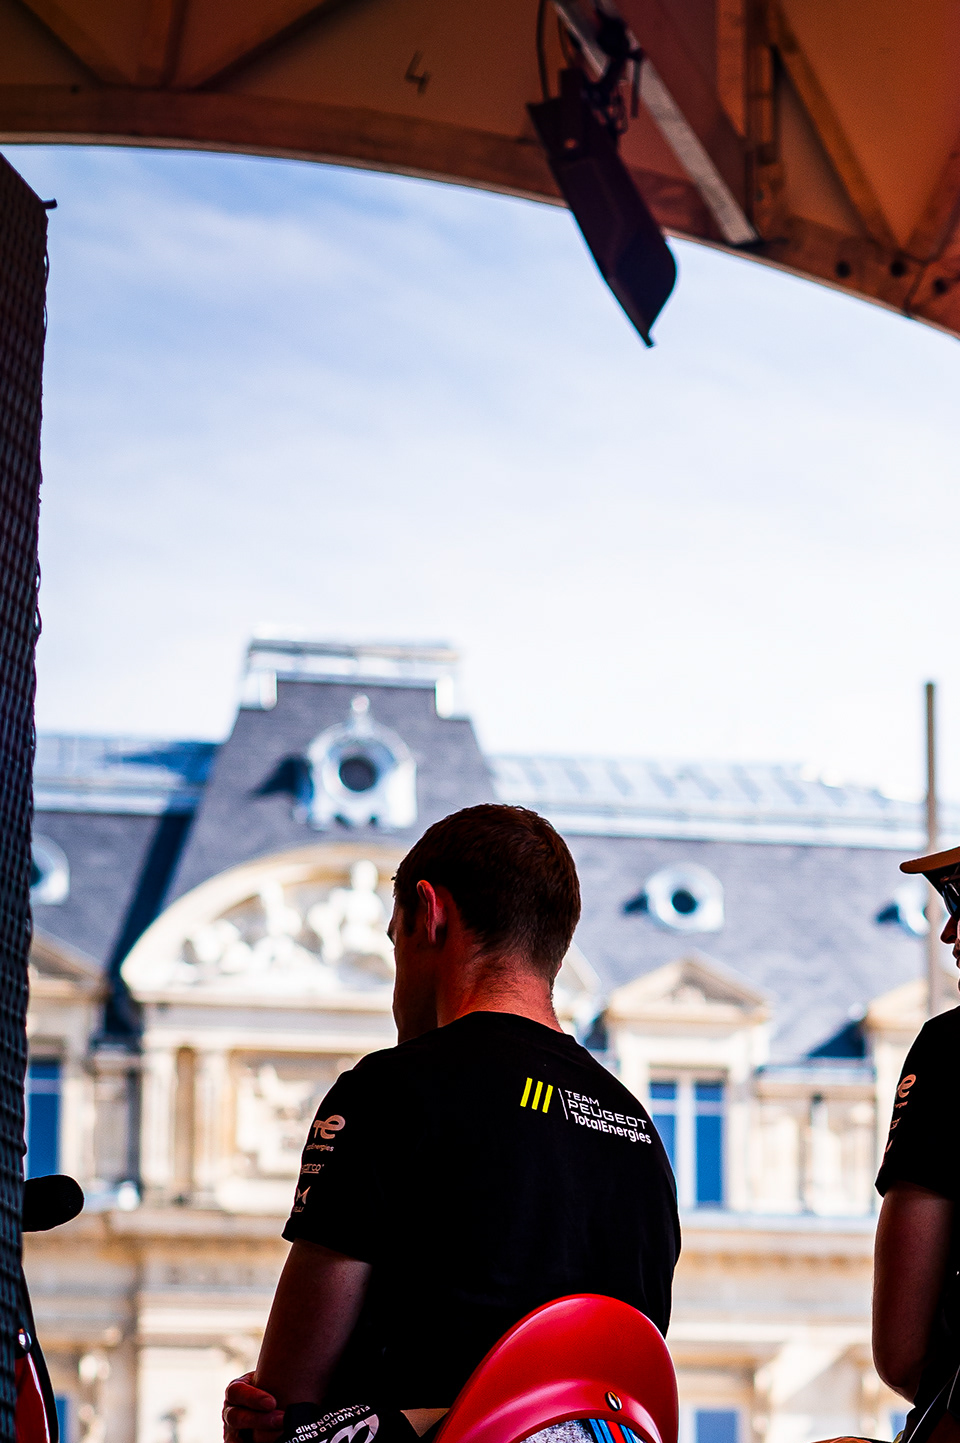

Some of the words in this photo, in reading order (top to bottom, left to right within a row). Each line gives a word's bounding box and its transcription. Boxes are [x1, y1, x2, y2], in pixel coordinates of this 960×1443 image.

[564, 1089, 600, 1107] TEAM
[567, 1099, 647, 1129] PEUGEOT
[570, 1110, 652, 1144] TotalEnergies
[319, 1411, 355, 1433] WORLD
